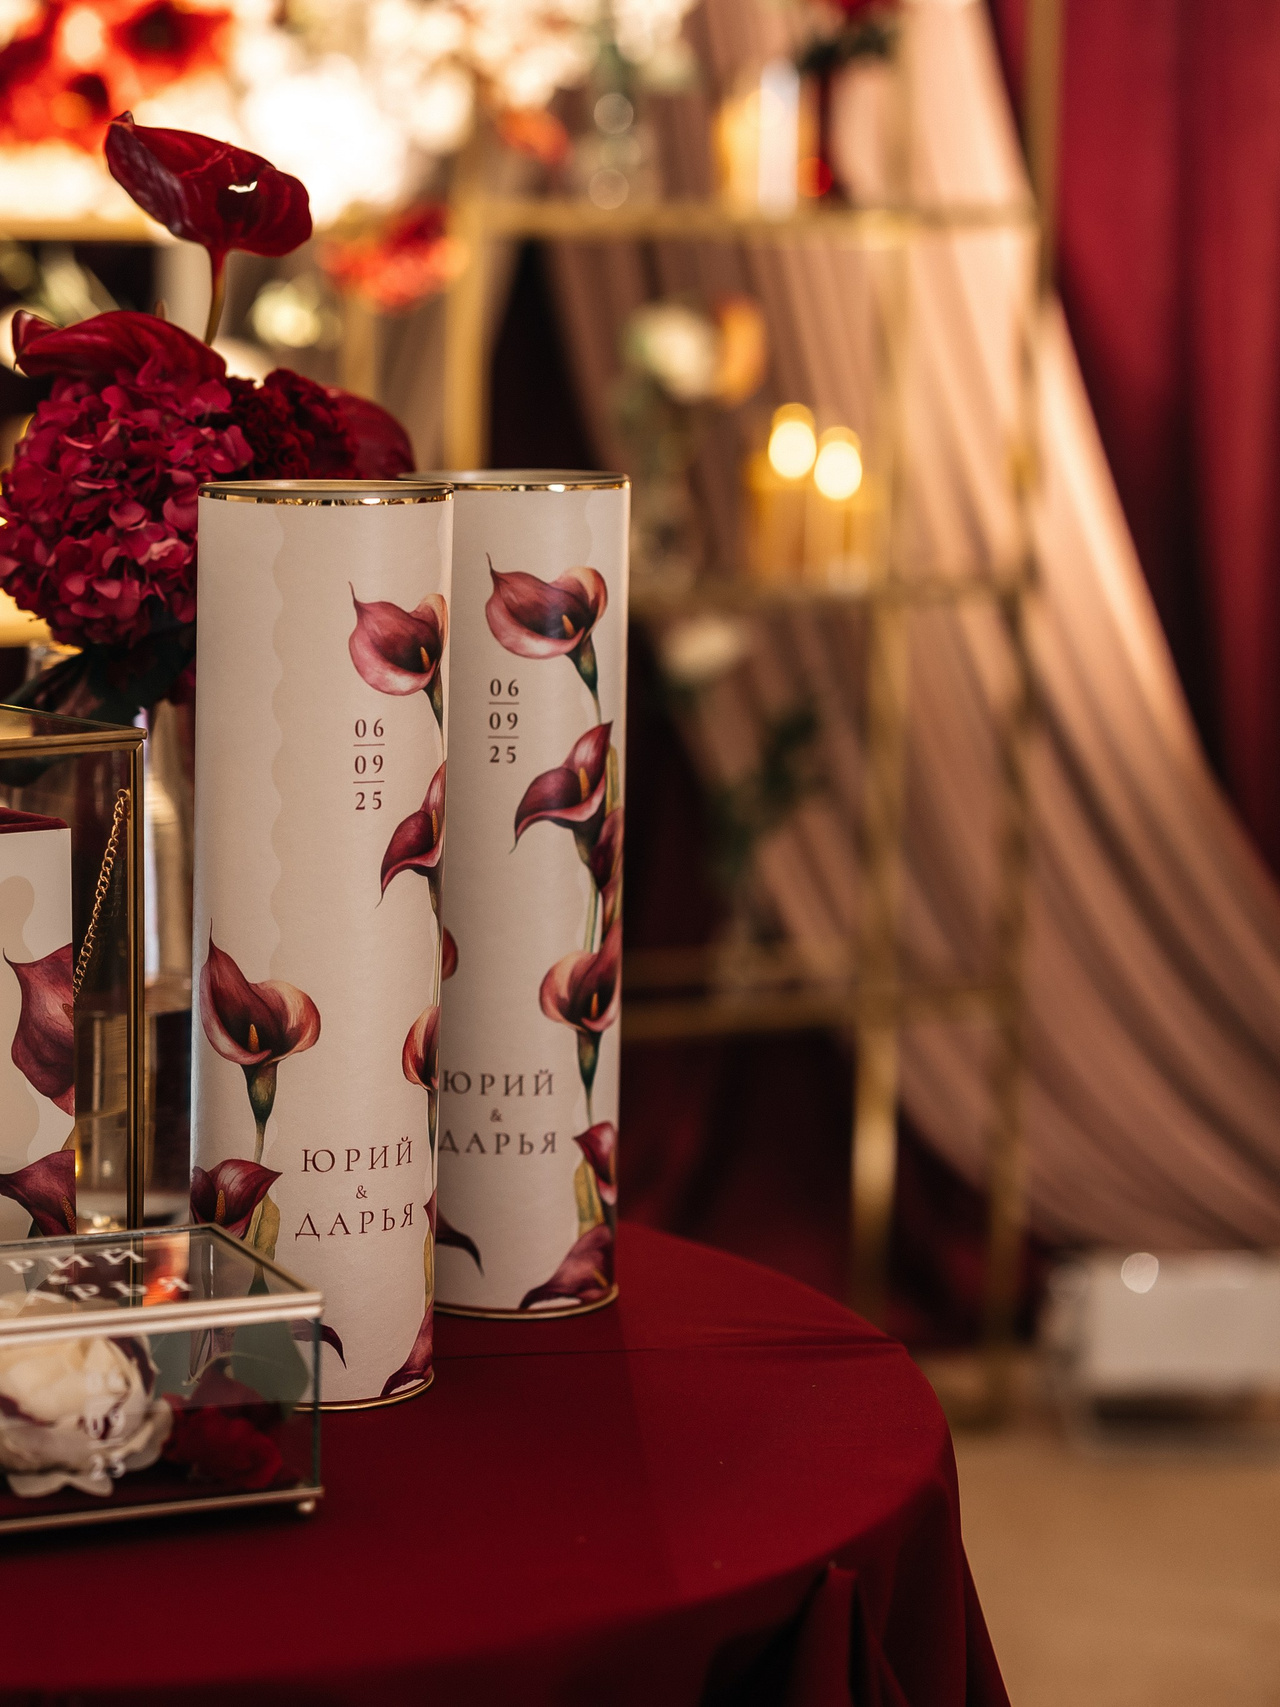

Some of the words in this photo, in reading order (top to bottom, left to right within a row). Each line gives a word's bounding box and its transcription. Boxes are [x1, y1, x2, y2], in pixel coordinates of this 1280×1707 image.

[490, 679, 519, 697] 06
[354, 718, 384, 738] 06
[489, 712, 519, 730] 09
[354, 754, 384, 774] 09
[489, 745, 517, 764] 25
[355, 791, 382, 811] 25
[442, 1068, 554, 1097] ЮРИЙ
[489, 1107, 502, 1122] &
[438, 1129, 556, 1155] ДАРЬЯ
[301, 1135, 414, 1173] ЮРИЙ
[355, 1184, 369, 1201] &
[294, 1202, 415, 1242] ДАРЬЯ
